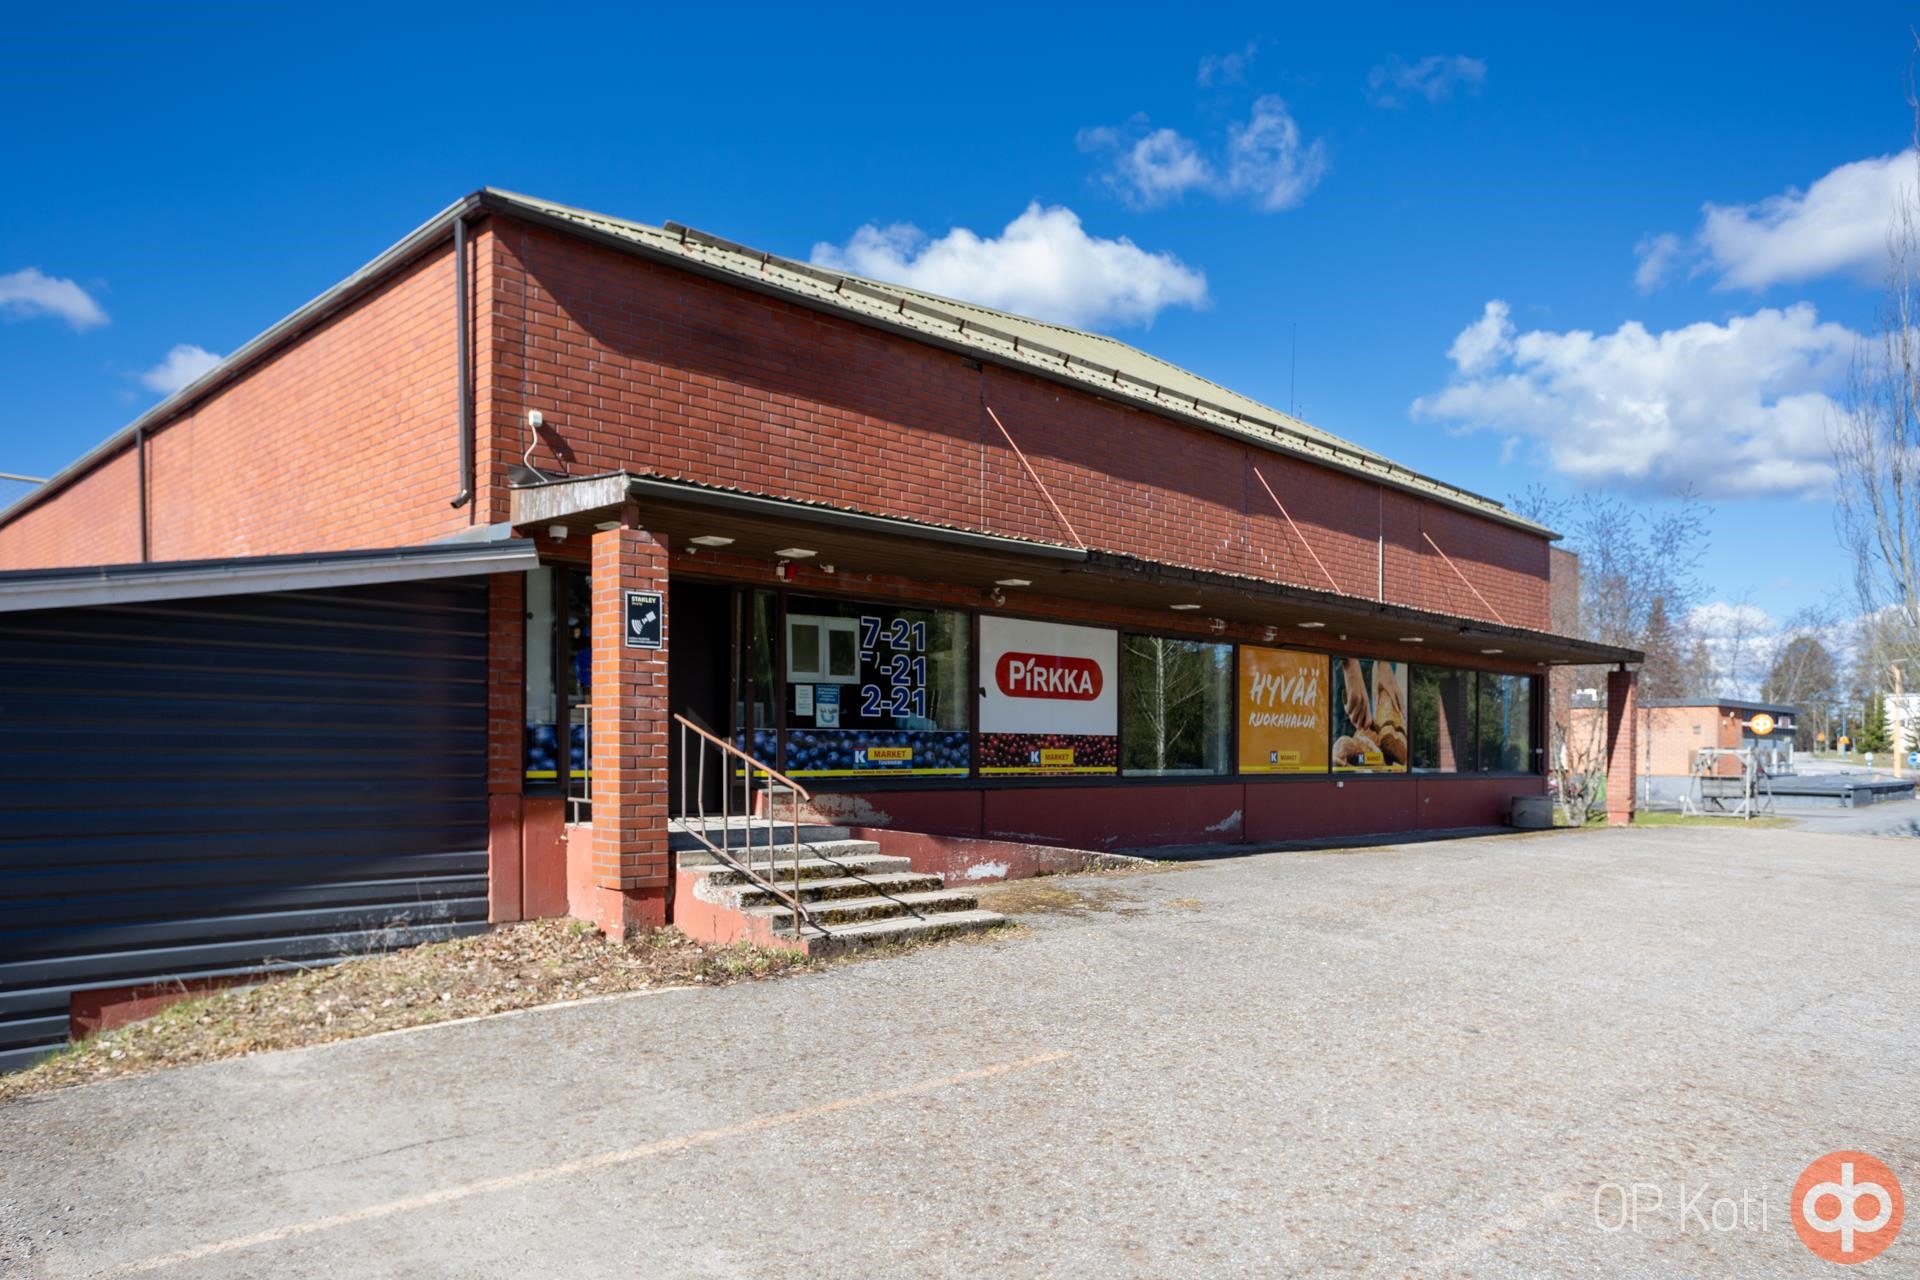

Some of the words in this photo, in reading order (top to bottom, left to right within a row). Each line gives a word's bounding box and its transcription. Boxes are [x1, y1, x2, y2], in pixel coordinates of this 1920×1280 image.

[631, 596, 657, 604] STANLEY
[861, 616, 926, 652] 7-21
[1250, 667, 1320, 707] HYVÄÄ
[861, 684, 926, 718] 2-21
[1249, 712, 1317, 729] RUOKAHALUA
[854, 750, 867, 764] K
[873, 750, 906, 758] MARKET
[1030, 751, 1040, 763] K
[1045, 753, 1069, 761] MARKET
